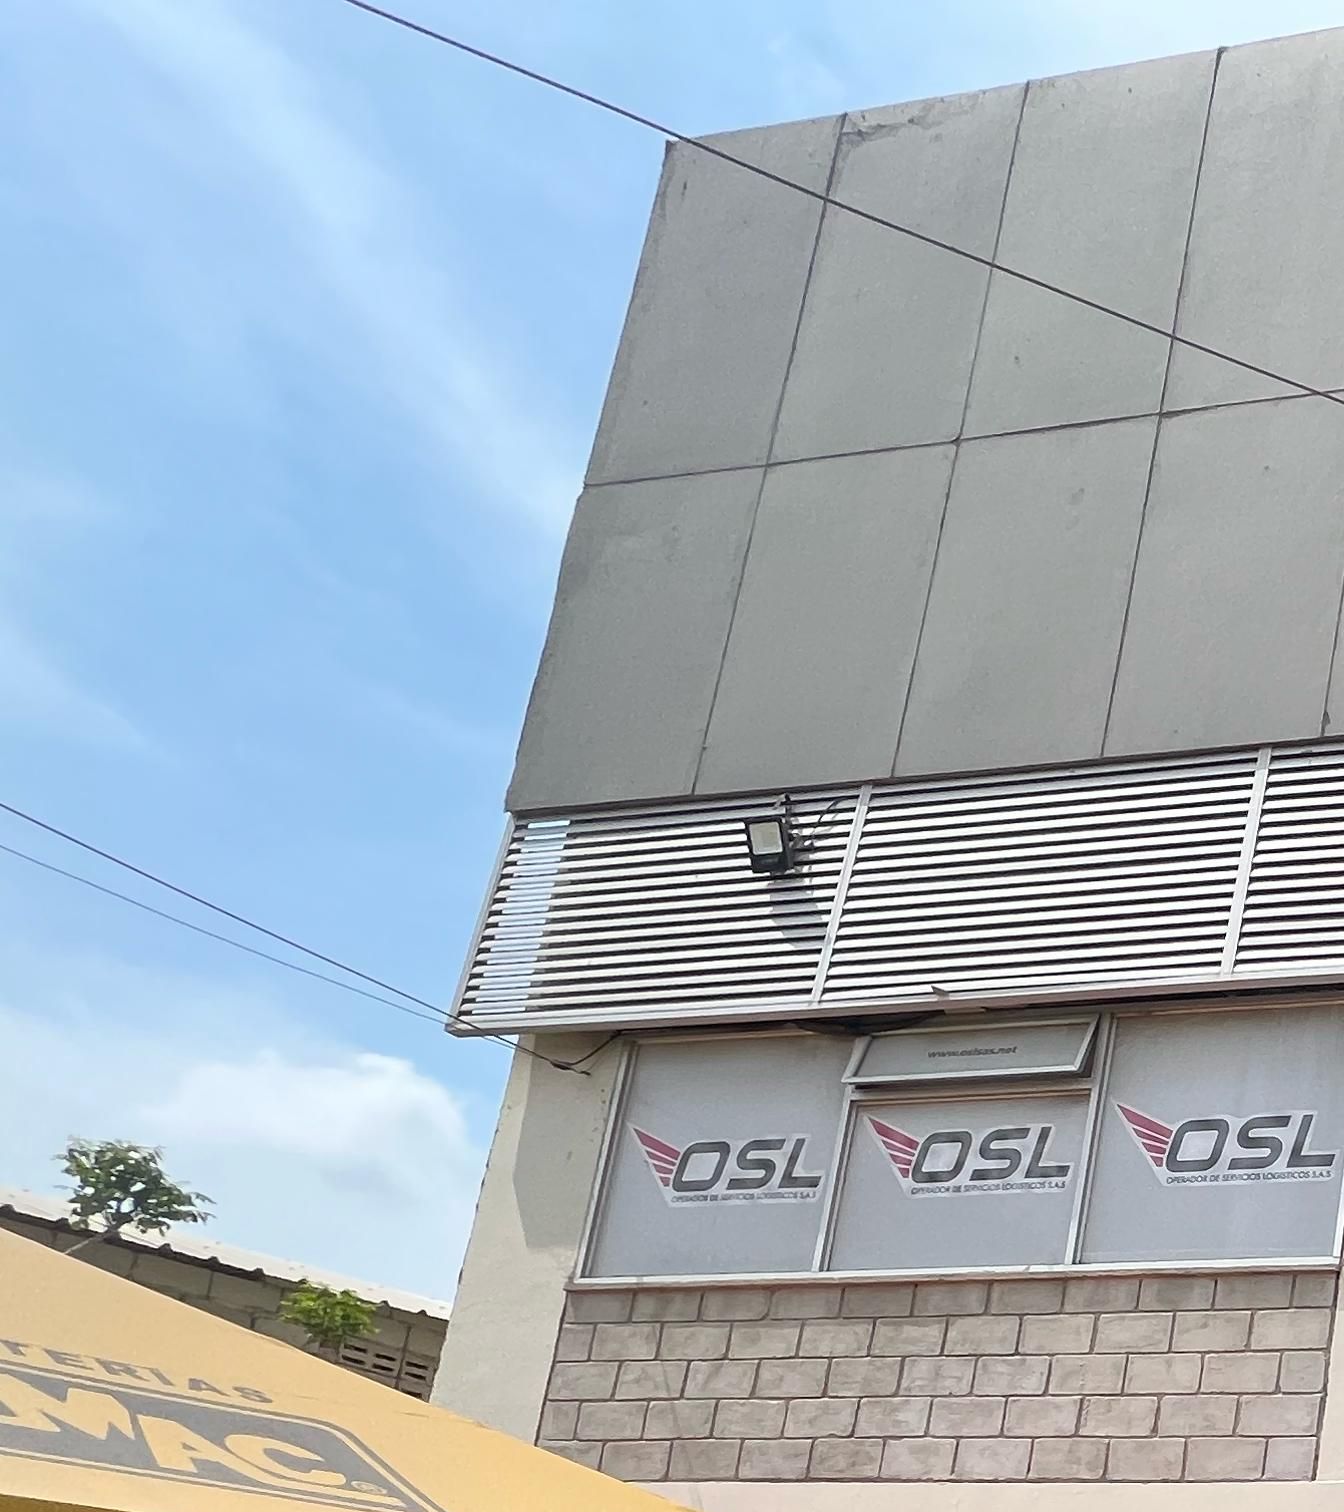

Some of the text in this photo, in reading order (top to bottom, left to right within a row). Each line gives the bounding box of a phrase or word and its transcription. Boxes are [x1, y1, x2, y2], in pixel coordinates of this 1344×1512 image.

[672, 1138, 822, 1192] OSL
[912, 1126, 1071, 1183] OSL
[1166, 1114, 1336, 1172] OSL
